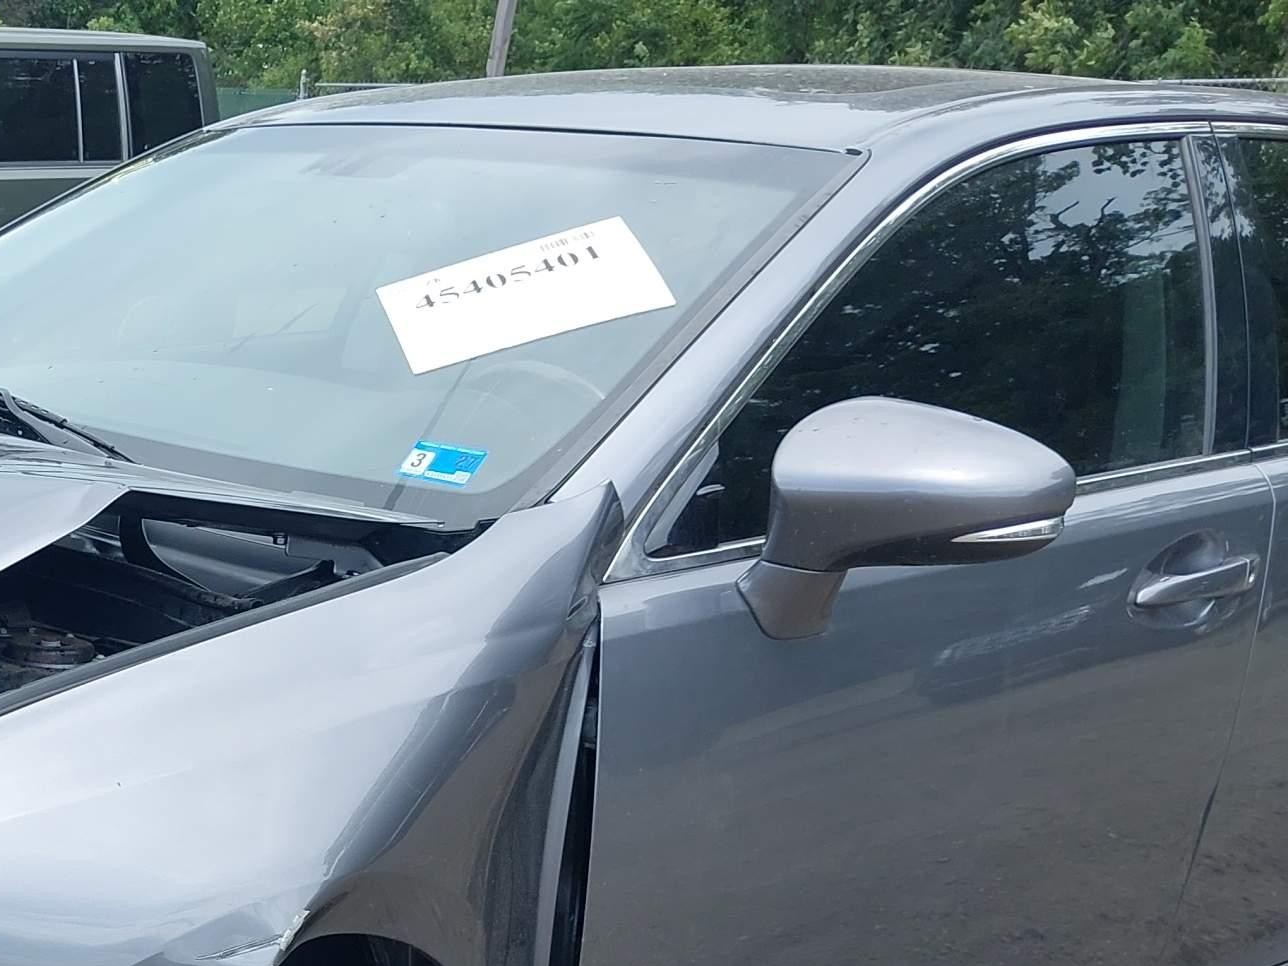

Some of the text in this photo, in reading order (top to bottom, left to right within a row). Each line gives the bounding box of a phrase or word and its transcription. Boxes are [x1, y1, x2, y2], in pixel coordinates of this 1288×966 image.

[416, 246, 600, 308] 45405401
[410, 452, 427, 468] 3
[455, 453, 480, 471] 27
